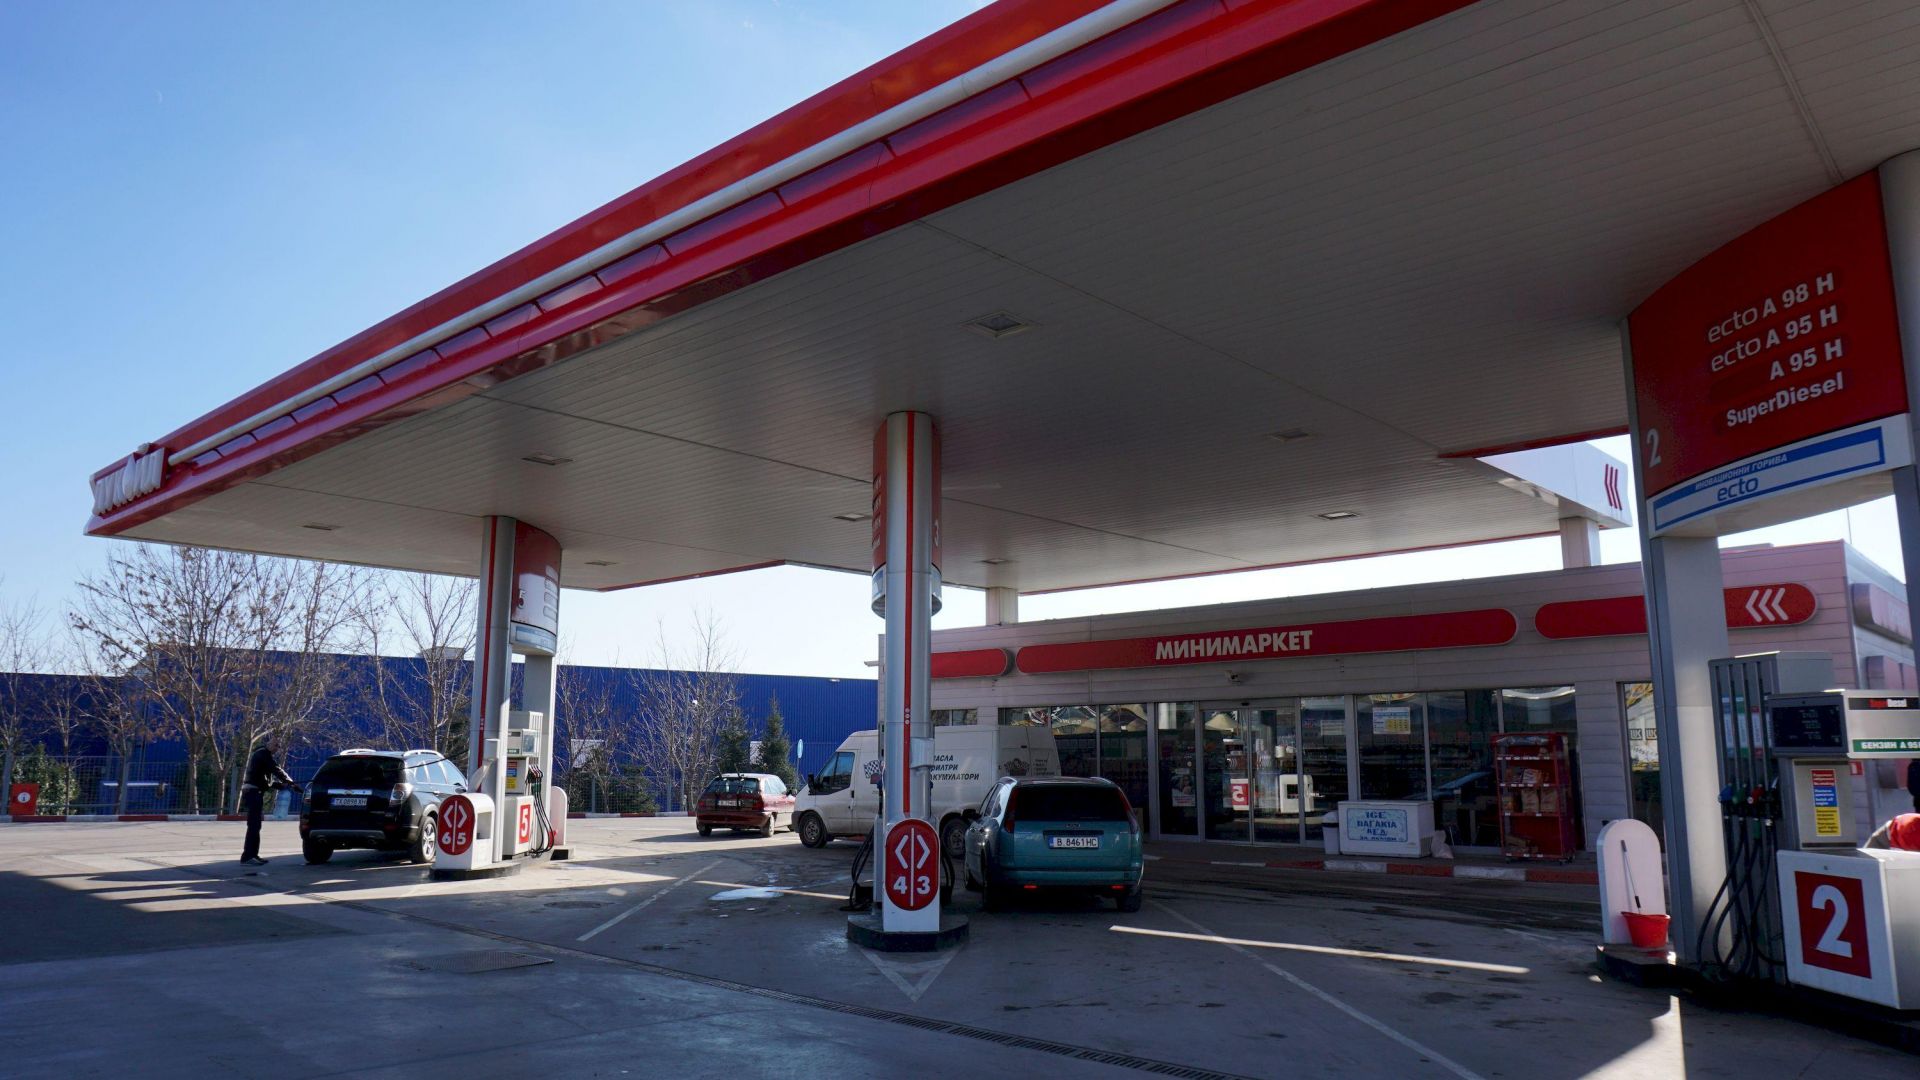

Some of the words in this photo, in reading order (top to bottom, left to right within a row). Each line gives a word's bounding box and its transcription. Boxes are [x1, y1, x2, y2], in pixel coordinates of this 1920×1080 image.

[1708, 307, 1758, 343] ecto
[1762, 297, 1777, 319] A
[1781, 282, 1809, 309] 98
[1815, 272, 1834, 296] H
[1711, 337, 1761, 372] ecto
[1765, 328, 1780, 349] A
[1785, 314, 1813, 340] 95
[1819, 304, 1838, 328] H
[1770, 360, 1785, 381] A
[1789, 346, 1817, 372] 95
[1824, 338, 1843, 361] H
[1726, 370, 1843, 427] SuperDiesel
[1647, 428, 1661, 468] 2
[1750, 454, 1788, 472] ГОРИВА
[1717, 477, 1758, 501] ecto
[1155, 630, 1313, 660] МИНИМАРКЕТ
[1861, 741, 1897, 749] БЕНЗИН
[441, 831, 452, 845] 6
[456, 832, 467, 845] 5
[521, 808, 530, 839] 5
[893, 875, 908, 895] 4
[916, 875, 930, 895] 3
[1811, 884, 1853, 959] 2
